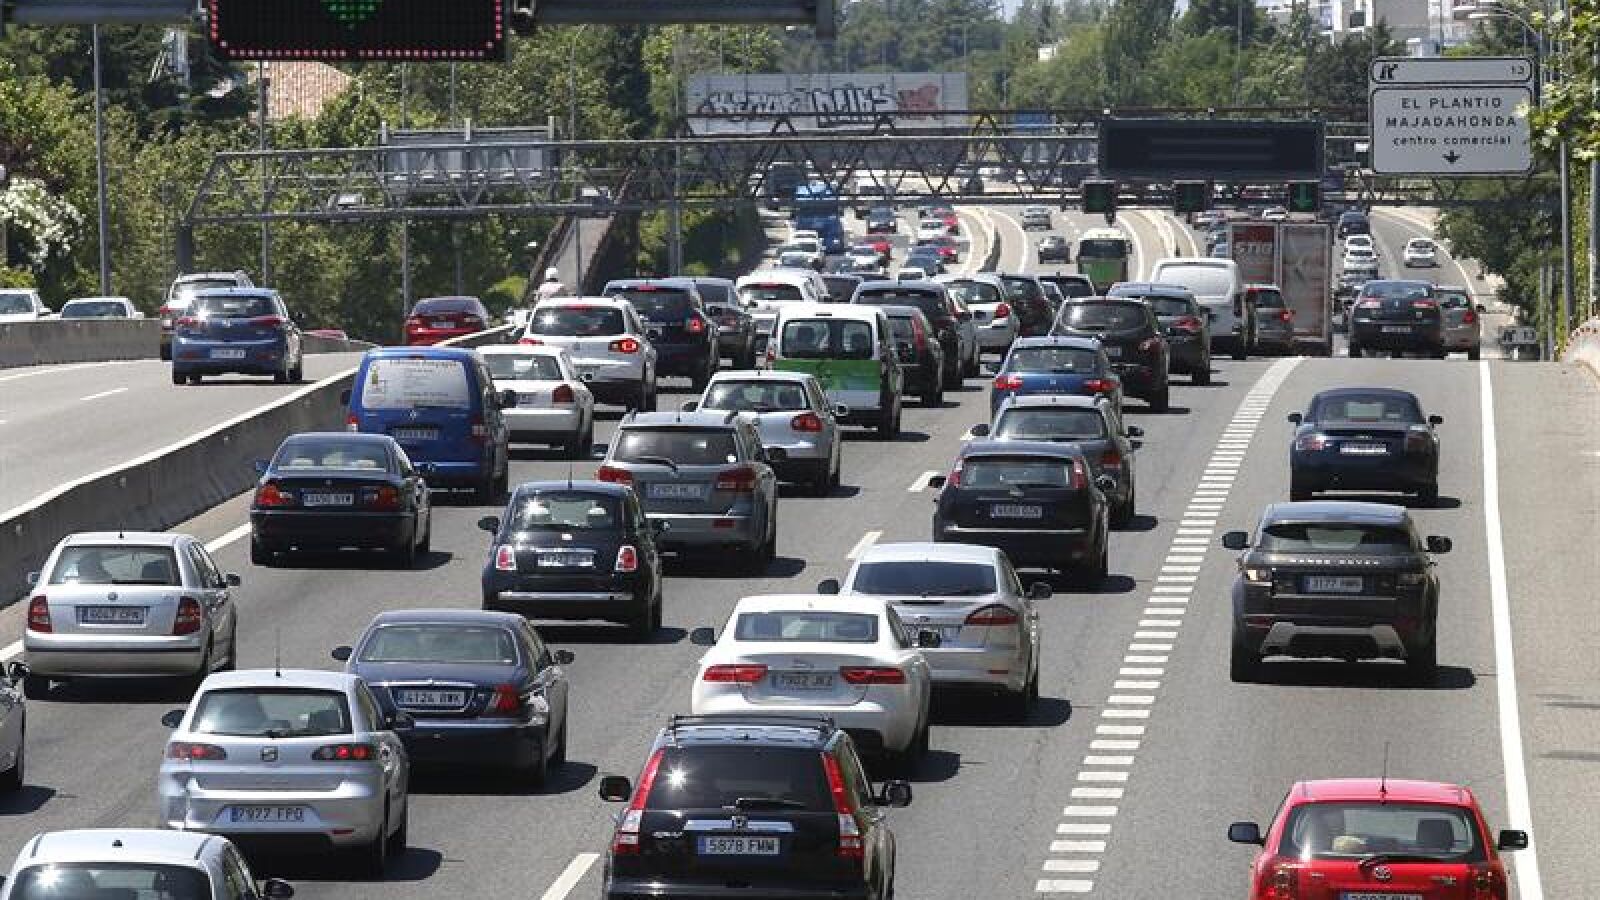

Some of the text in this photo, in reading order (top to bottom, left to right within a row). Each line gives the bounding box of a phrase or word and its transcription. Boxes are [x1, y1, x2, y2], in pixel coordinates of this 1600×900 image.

[1401, 98, 1502, 108] EL PLANTIO
[1386, 116, 1517, 127] MAJADAHONDA
[1392, 135, 1511, 145] centro comercial
